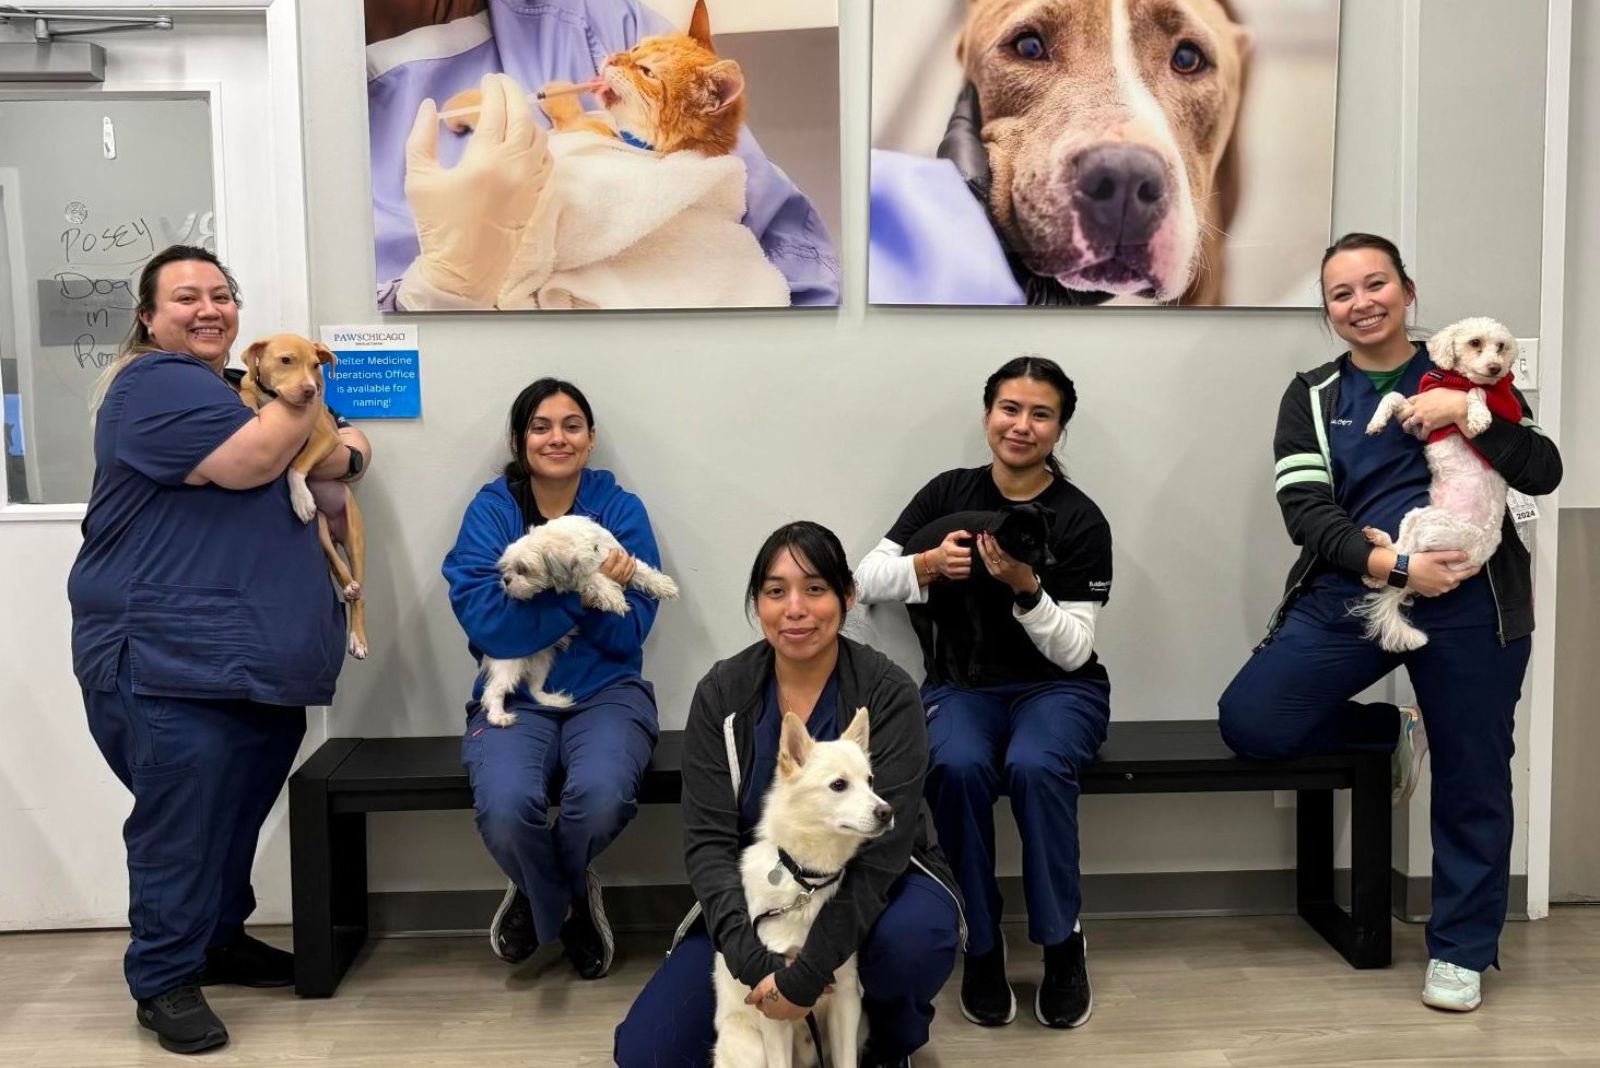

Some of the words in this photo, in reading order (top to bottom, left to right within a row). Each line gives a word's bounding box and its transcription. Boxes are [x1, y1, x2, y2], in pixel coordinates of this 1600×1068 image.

[86, 308, 108, 328] in
[336, 356, 365, 365] helter
[367, 356, 412, 365] Medicine
[385, 370, 416, 379] Office
[336, 385, 345, 393] is
[346, 384, 391, 393] available
[393, 383, 408, 392] for
[353, 398, 391, 408] naming!
[1516, 510, 1535, 520] 2024
